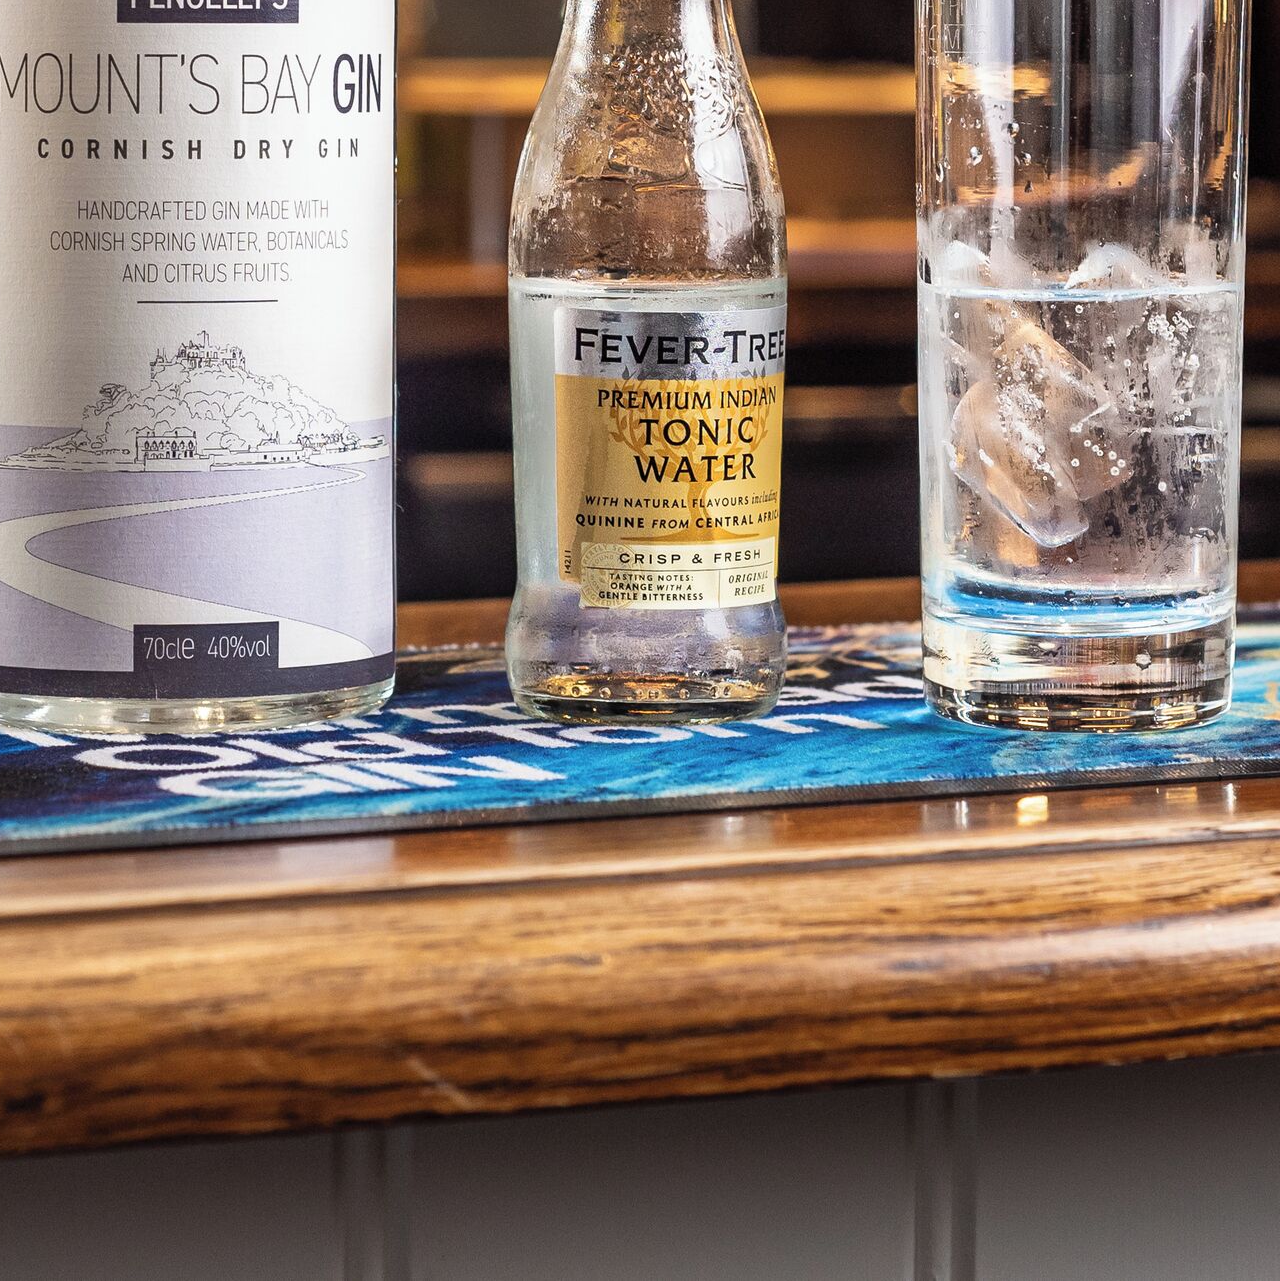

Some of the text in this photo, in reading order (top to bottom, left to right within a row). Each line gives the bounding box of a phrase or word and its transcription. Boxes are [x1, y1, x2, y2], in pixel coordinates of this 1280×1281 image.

[240, 53, 321, 115] BAY
[332, 52, 382, 114] GIN
[37, 137, 360, 160] CORNISH DRY GIN
[76, 198, 329, 221] HANDCRAFTED GIN MADE WITH
[49, 229, 349, 254] CORNISH SPRING WATER, BOTANICALS
[121, 262, 294, 284] AND CITRUS FRUITS.
[574, 327, 785, 365] FEVER-TREE
[597, 385, 777, 410] PREMIUM INDIAN
[638, 416, 754, 446] TONIC
[633, 452, 757, 483] WATER
[585, 495, 619, 507] WITH
[623, 497, 687, 509] NATURAL
[692, 495, 749, 508] FLAVOURS
[575, 508, 779, 529] QUININE FROM CENTRAL AFRIC
[619, 552, 682, 565] CRISP
[691, 552, 704, 565] &
[713, 548, 762, 563] FRESH
[609, 573, 695, 582] TASTING NOTES:
[610, 582, 693, 591] ORANGE WITH A
[728, 569, 769, 584] ORIGINAL
[598, 591, 704, 601] GENTLE BITTERNESS
[734, 584, 766, 596] RECIPE
[207, 635, 271, 659] 40%vol
[72, 730, 453, 772] Old
[157, 756, 568, 798] GIN
